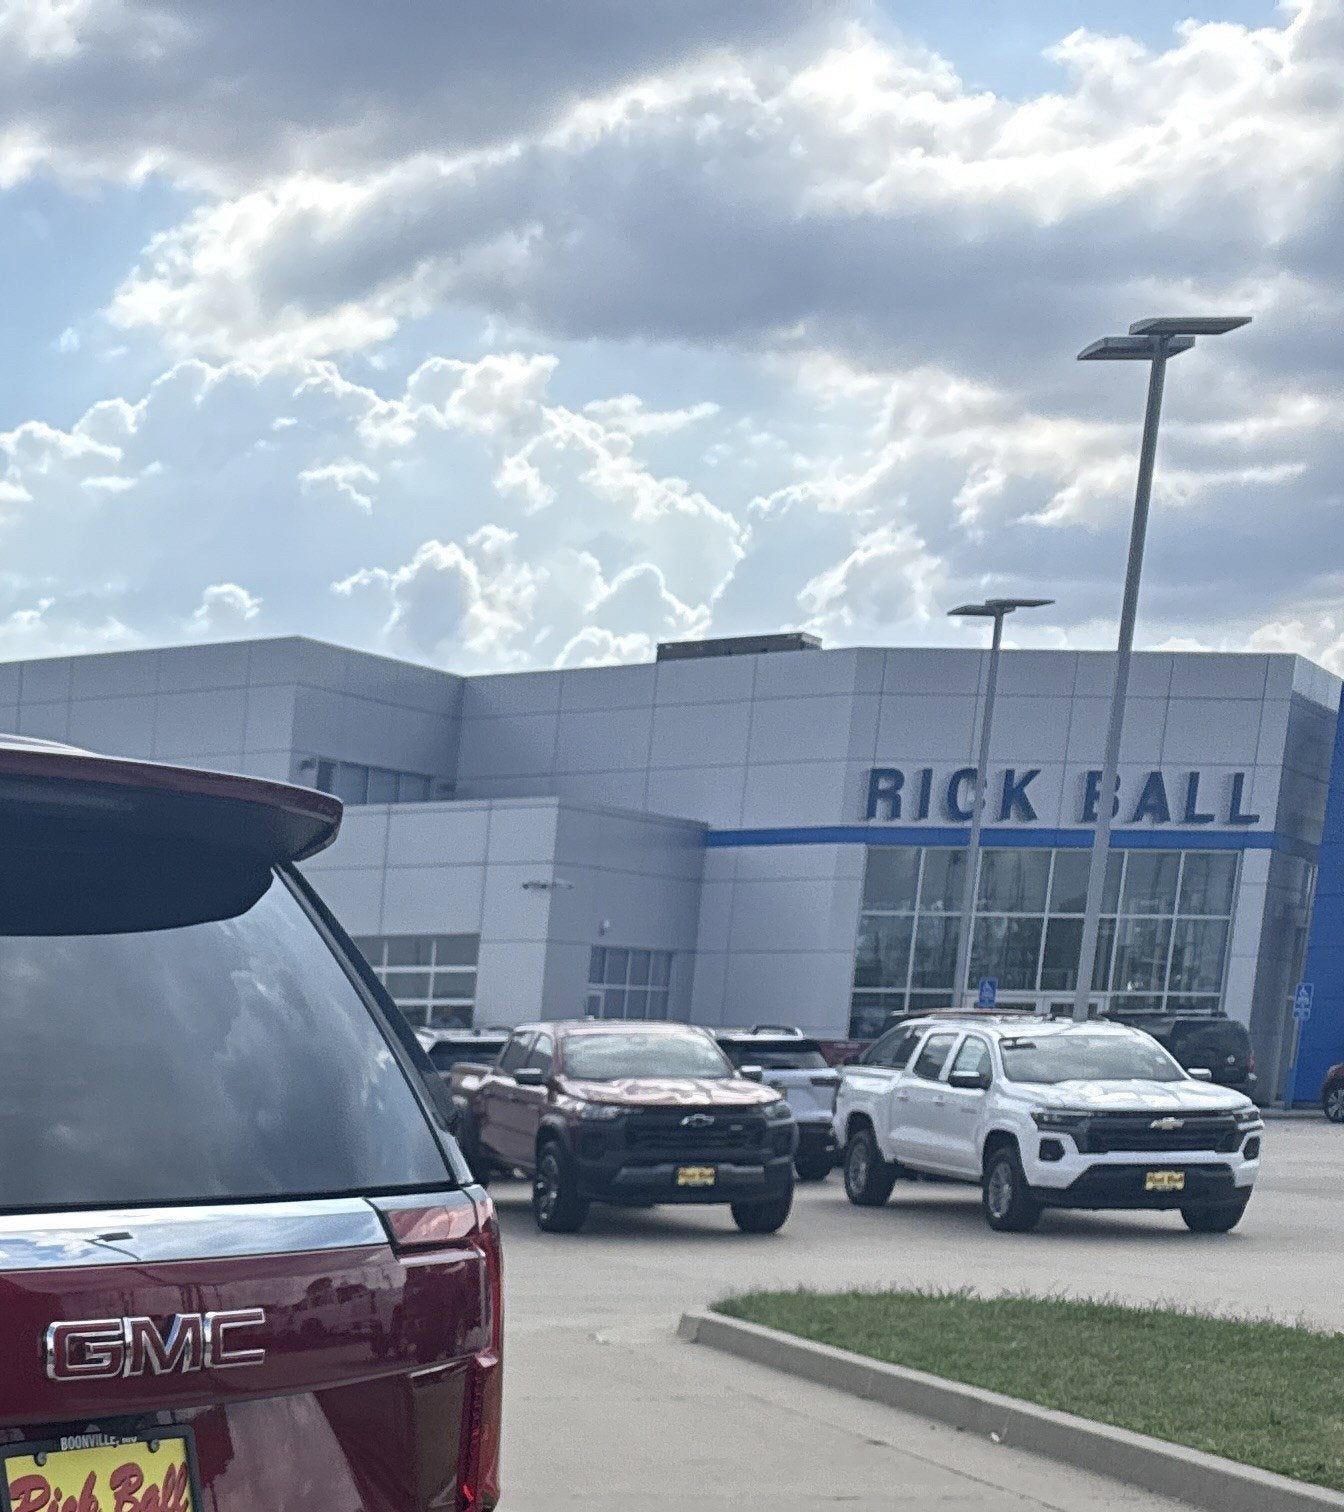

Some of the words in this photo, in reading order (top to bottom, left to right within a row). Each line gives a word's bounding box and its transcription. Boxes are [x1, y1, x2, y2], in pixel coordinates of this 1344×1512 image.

[865, 766, 1041, 823] RICK
[1079, 768, 1261, 825] BALL
[46, 1308, 265, 1381] GMC
